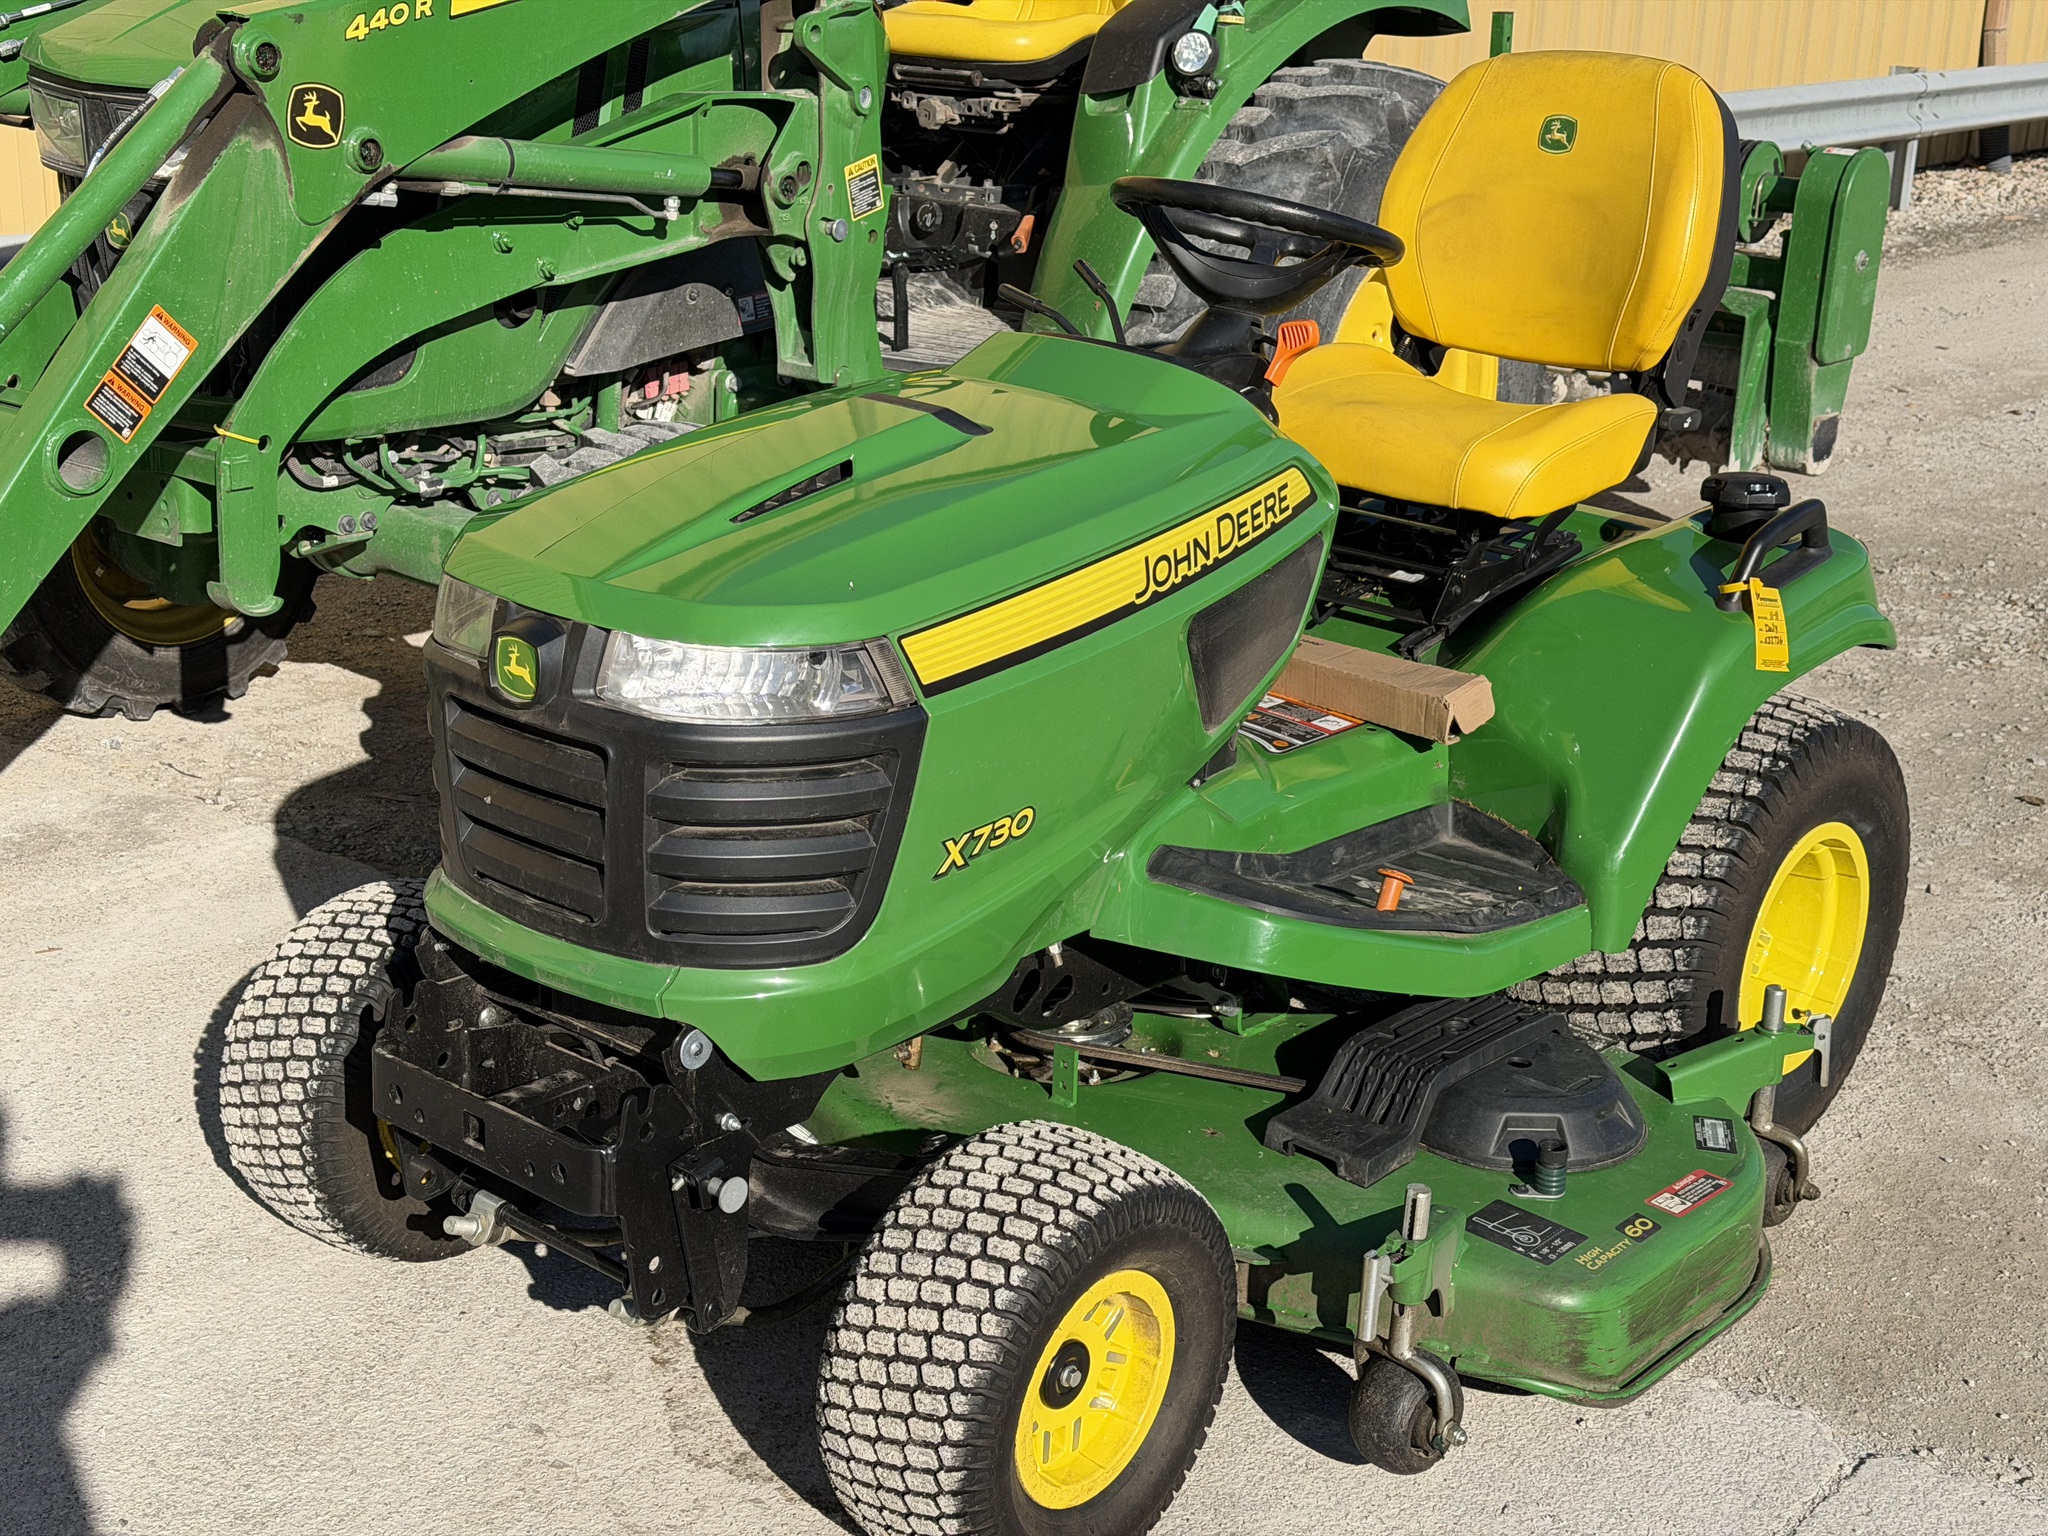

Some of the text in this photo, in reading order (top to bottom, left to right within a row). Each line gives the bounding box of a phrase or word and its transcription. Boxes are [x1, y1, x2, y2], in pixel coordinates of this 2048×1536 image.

[854, 157, 876, 173] CAUTION
[163, 317, 191, 346] WARNING
[116, 384, 145, 412] WARNING
[1134, 481, 1291, 602] JOHN DEERE
[932, 805, 1036, 880] X730
[1624, 1218, 1654, 1238] 60
[1575, 1246, 1603, 1266] HIGH
[1586, 1238, 1632, 1271] CAPACITY
